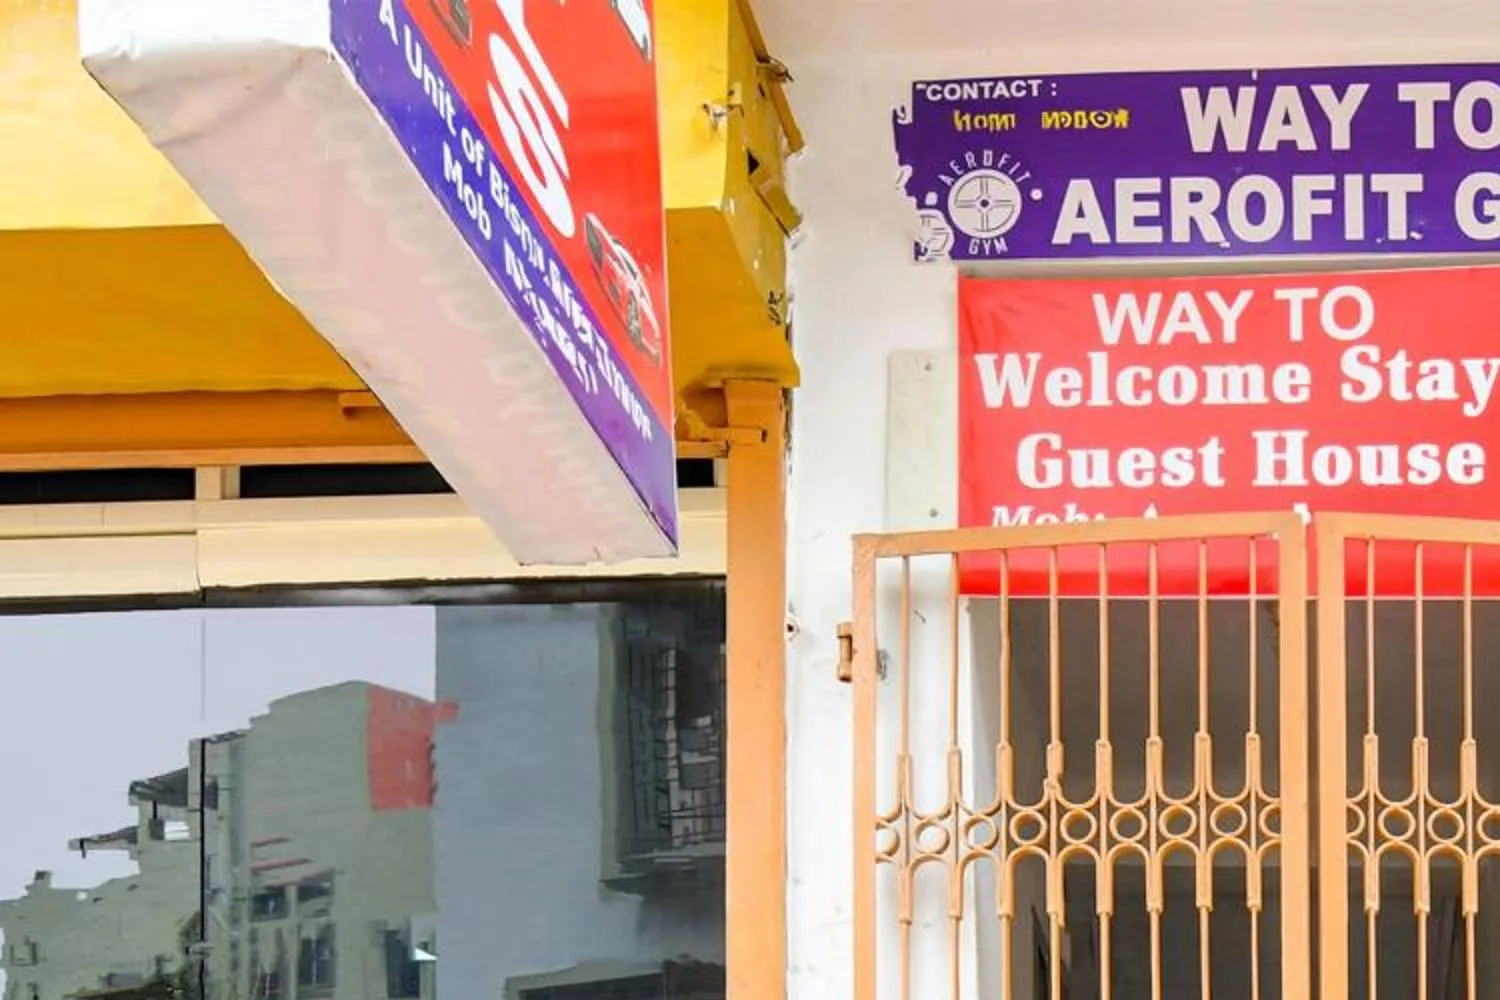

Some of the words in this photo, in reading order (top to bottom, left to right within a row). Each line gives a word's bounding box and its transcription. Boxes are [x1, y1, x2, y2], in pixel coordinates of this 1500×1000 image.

[404, 24, 457, 136] Unit
[460, 127, 485, 177] of
[926, 79, 1043, 101] CONTACT
[1181, 83, 1370, 152] WAY
[443, 140, 491, 241] Mob
[938, 149, 1032, 187] AEROFIT
[1051, 174, 1423, 246] AEROFIT
[968, 236, 1008, 255] GYM
[1092, 290, 1253, 345] WAY
[1275, 285, 1374, 341] TO
[975, 351, 1312, 408] Welcome
[1016, 433, 1226, 489] Guest
[1252, 430, 1486, 486] House
